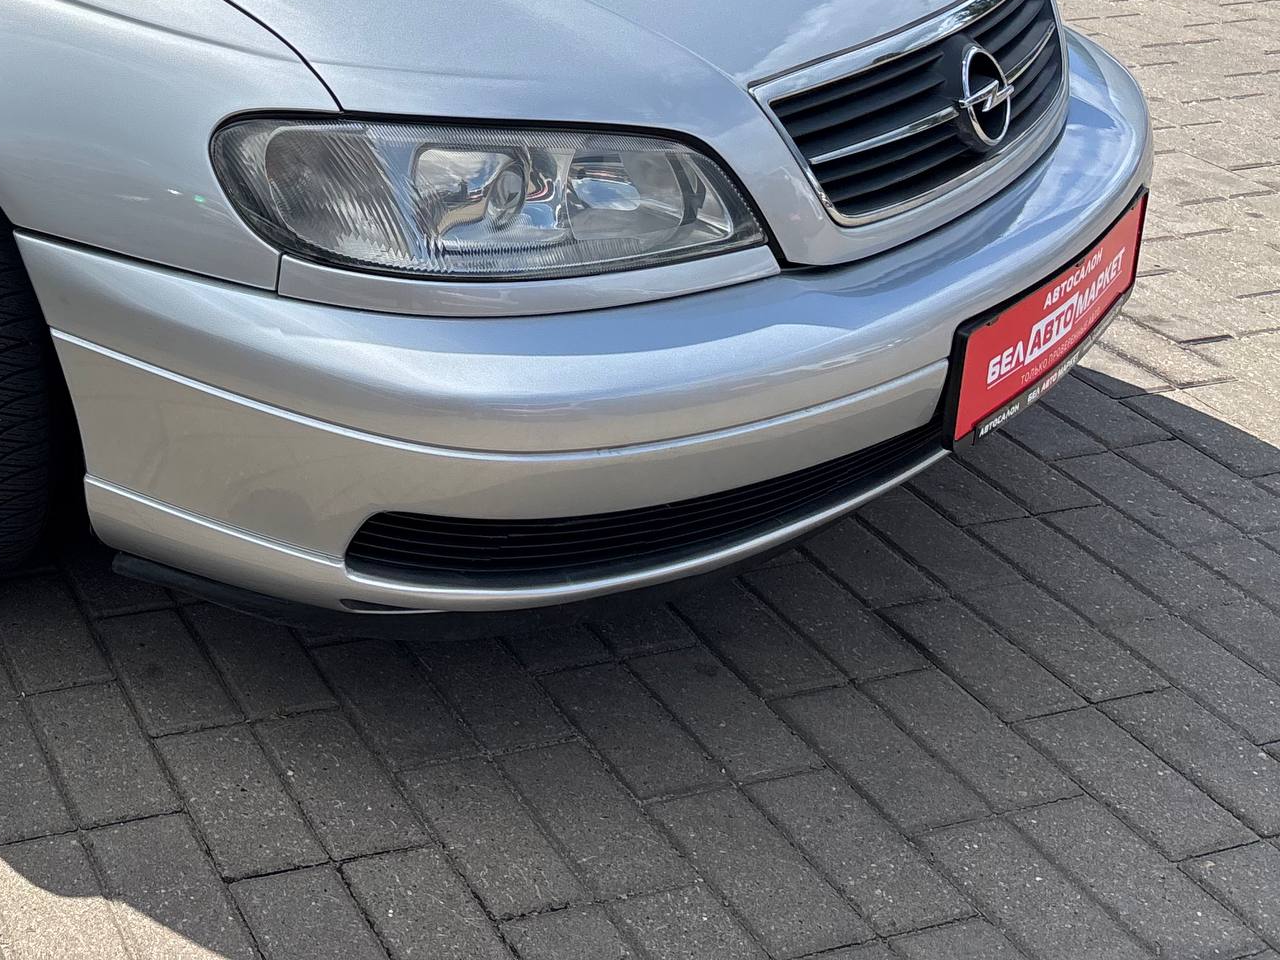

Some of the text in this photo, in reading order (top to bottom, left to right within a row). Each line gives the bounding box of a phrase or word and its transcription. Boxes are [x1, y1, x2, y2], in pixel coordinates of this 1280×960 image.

[1043, 247, 1104, 310] АВТОСАЛОН
[1020, 358, 1048, 385] ТОЛЬКО
[979, 402, 1020, 438] АВТОСАЛОН
